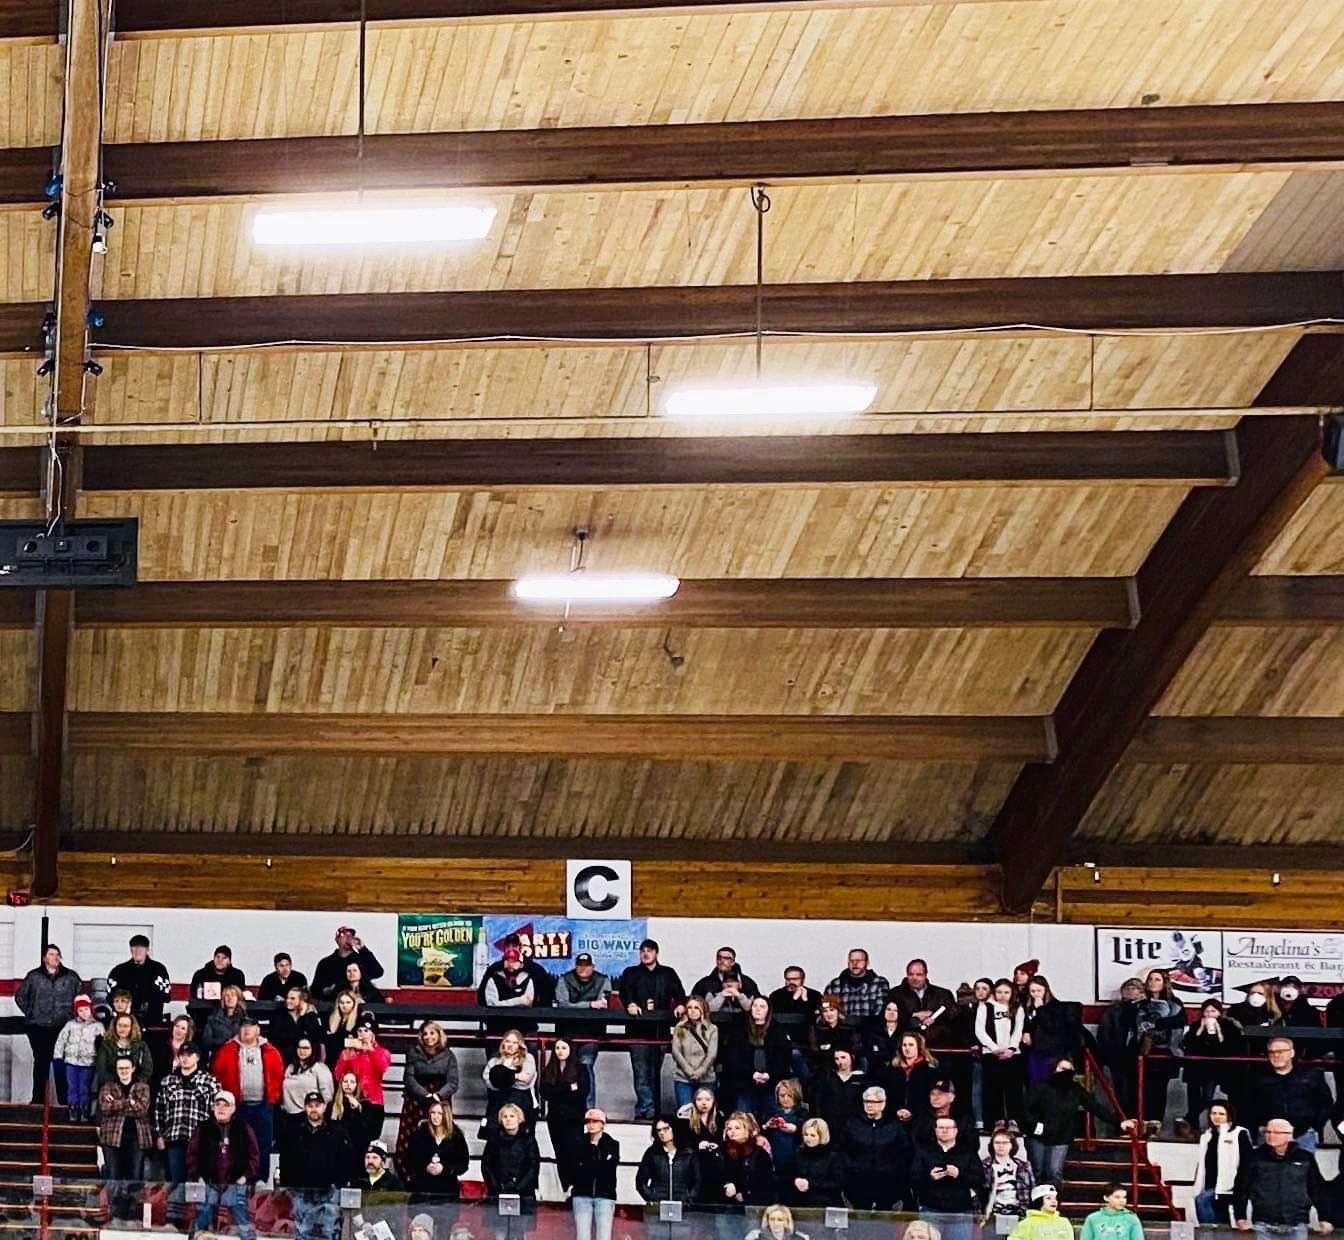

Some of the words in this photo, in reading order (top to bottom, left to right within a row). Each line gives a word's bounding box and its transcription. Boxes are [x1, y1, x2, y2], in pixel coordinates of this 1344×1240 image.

[574, 866, 620, 912] C
[401, 930, 435, 949] YOU'RE
[435, 926, 474, 945] GOLDEN
[518, 931, 570, 946] ARTY
[578, 939, 600, 951] BIG
[603, 940, 640, 952] WAVE
[520, 944, 568, 958] ONE!
[1112, 936, 1162, 965] Lite
[1227, 936, 1321, 963] Angelina's
[1227, 959, 1301, 971] Restaurant
[1320, 962, 1343, 972] Bar
